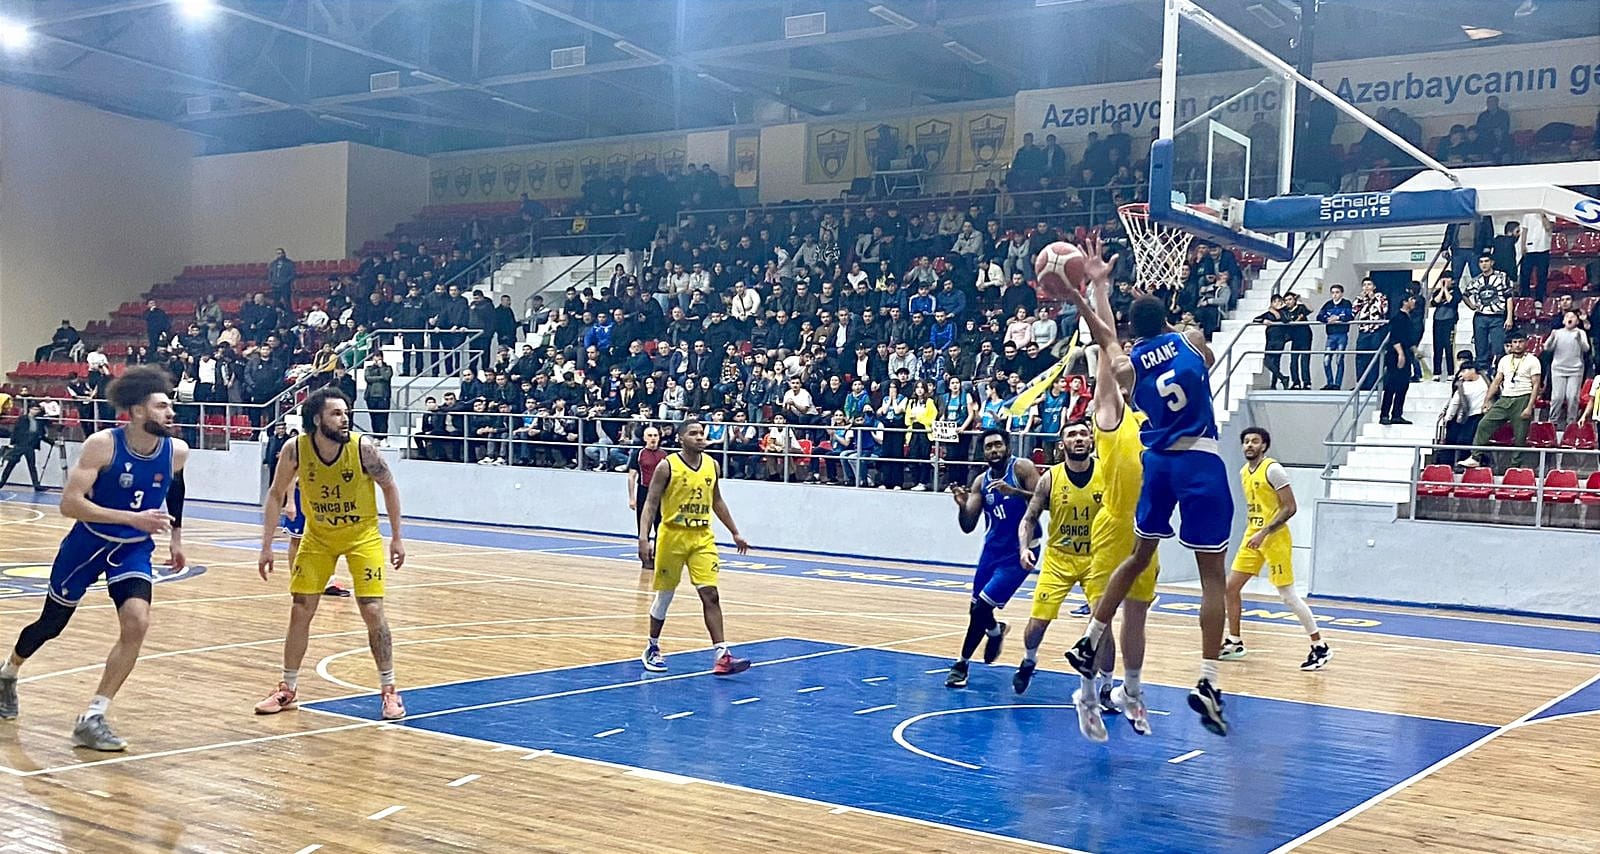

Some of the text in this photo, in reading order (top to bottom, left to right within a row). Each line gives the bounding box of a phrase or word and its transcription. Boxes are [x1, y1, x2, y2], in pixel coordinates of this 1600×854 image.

[1042, 97, 1197, 129] Azərbaycn
[1320, 194, 1391, 209] Schelde
[1320, 206, 1391, 222] Sports
[1140, 341, 1179, 370] CRANE
[1156, 368, 1188, 412] 5
[321, 484, 341, 499] 34
[130, 490, 144, 509] 3
[344, 501, 357, 513] BK
[993, 504, 1006, 520] 41
[1072, 505, 1089, 520] 14
[1072, 541, 1092, 554] VT
[363, 566, 382, 581] 34
[1270, 564, 1283, 575] 31
